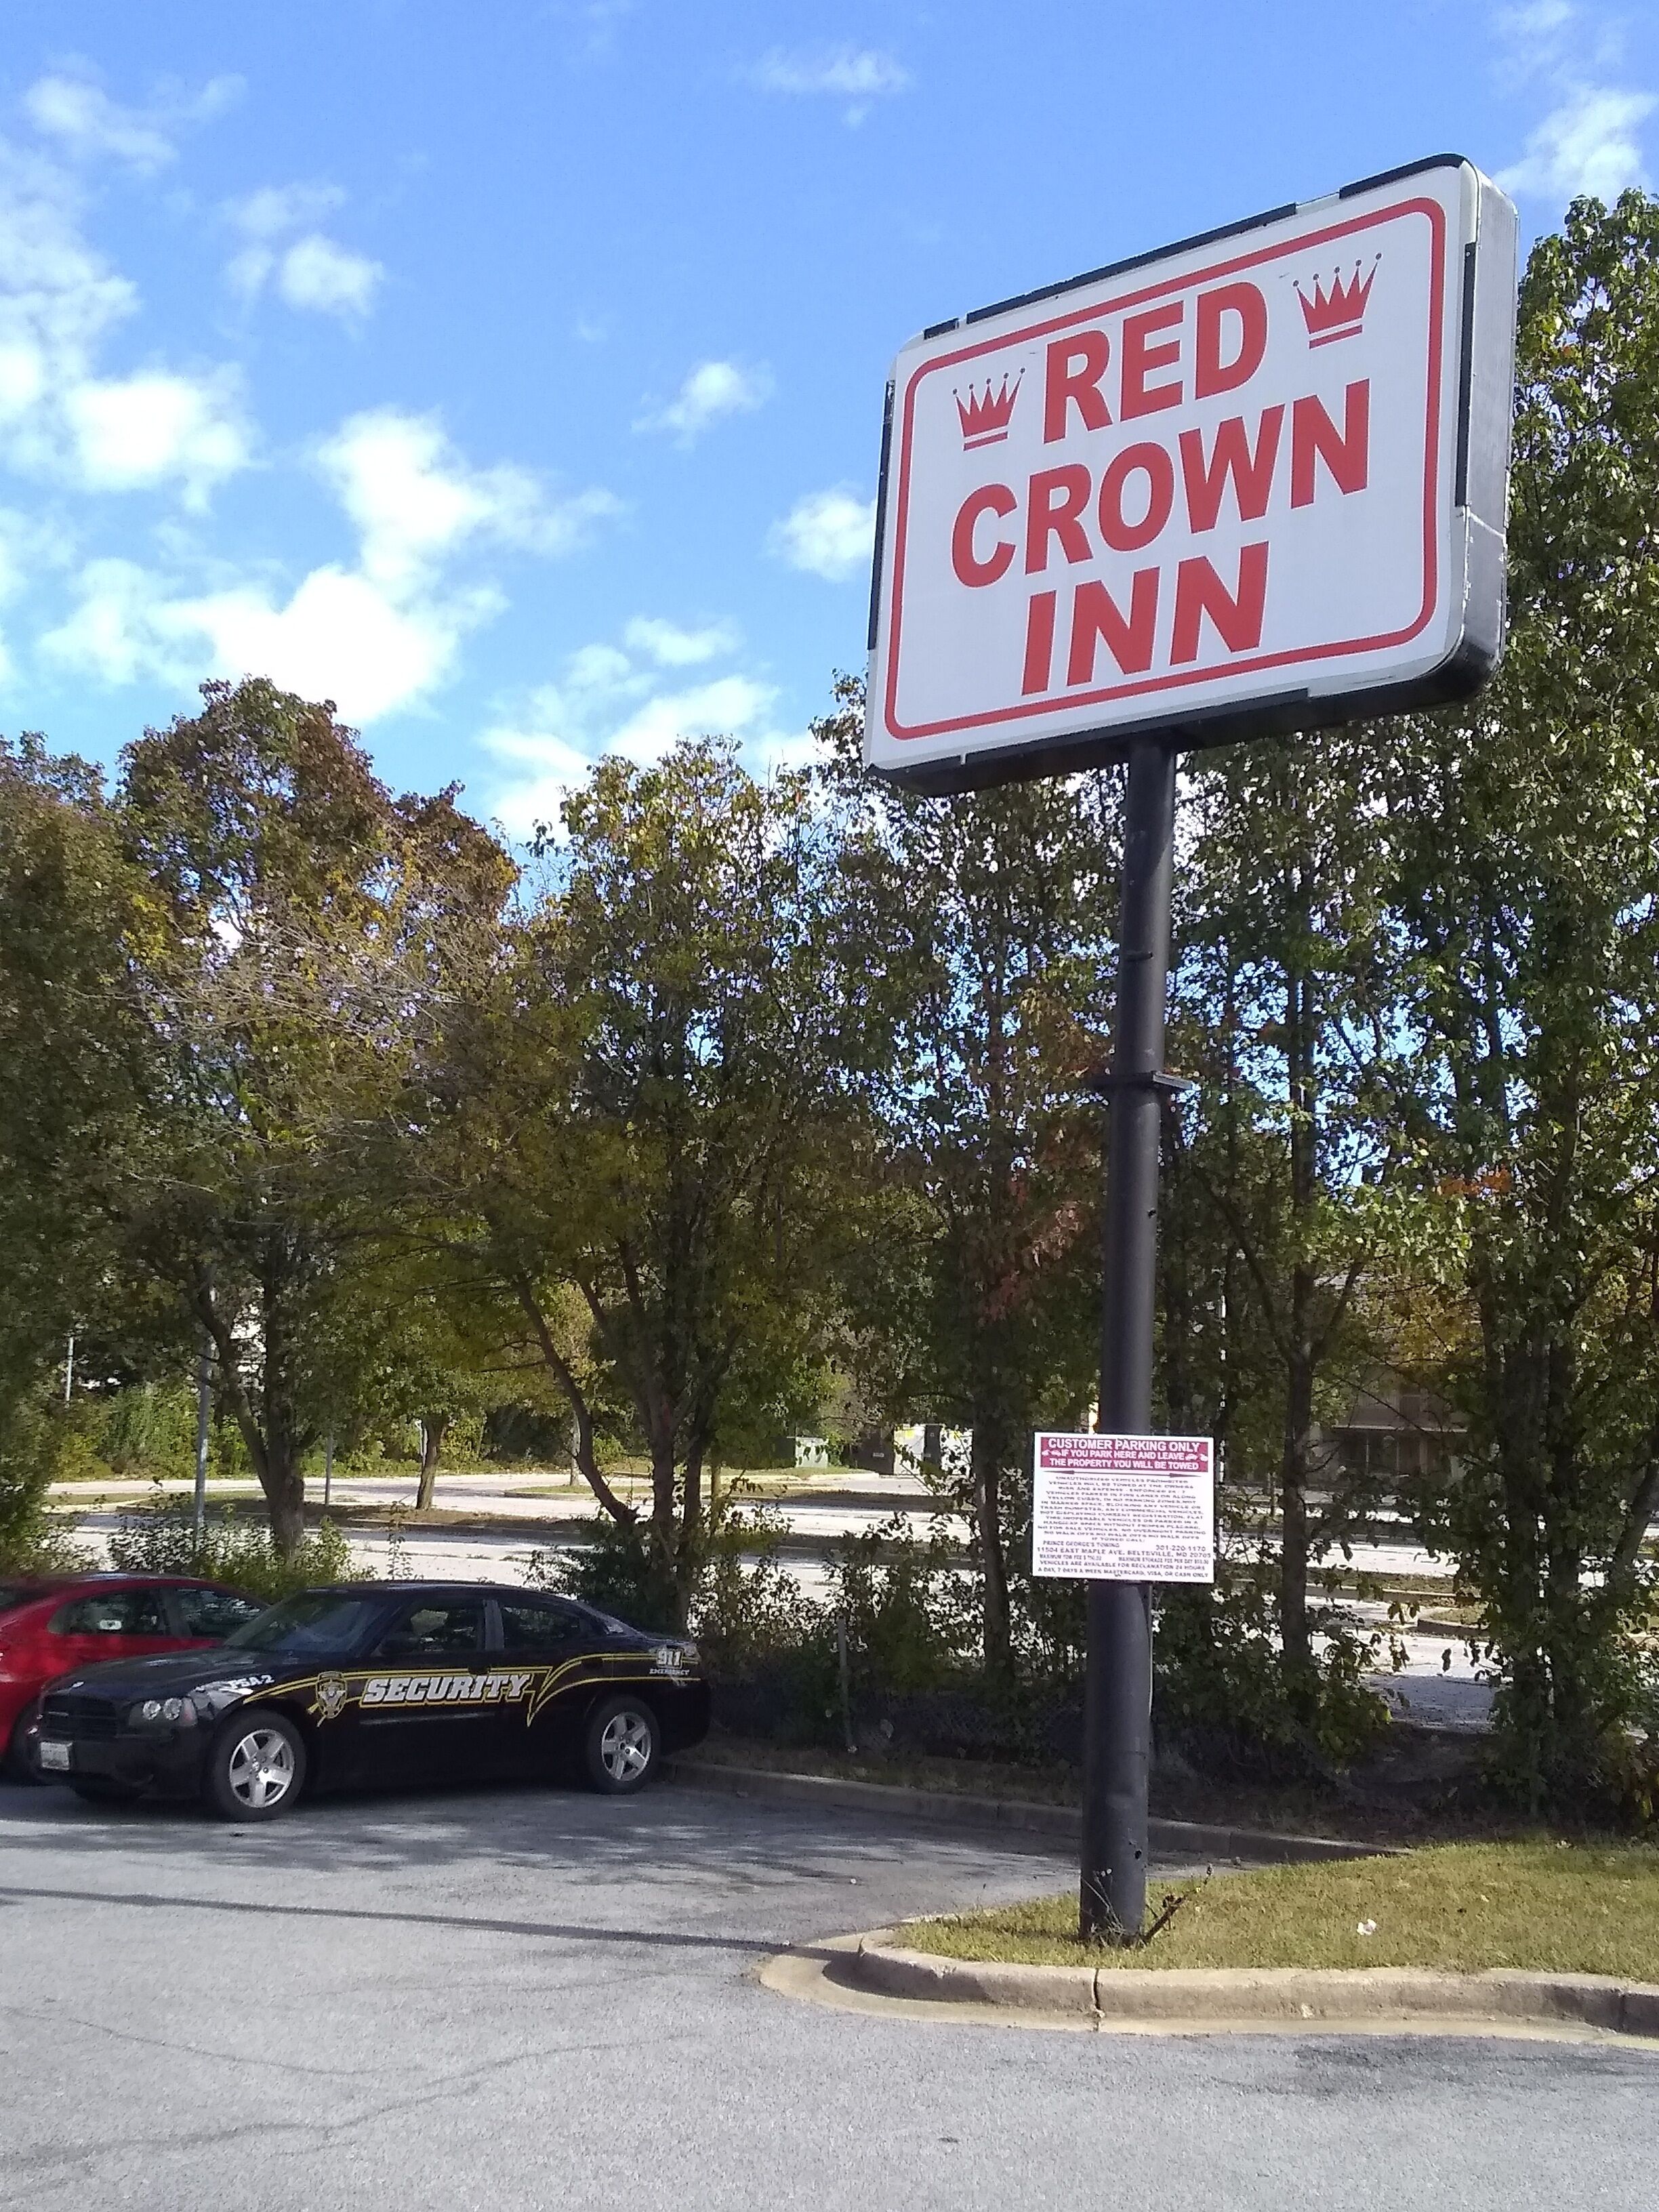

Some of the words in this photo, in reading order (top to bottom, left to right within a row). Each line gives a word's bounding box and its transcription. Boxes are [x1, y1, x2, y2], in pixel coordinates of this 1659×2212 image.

[1043, 281, 1267, 444] RED
[951, 378, 1370, 588] CROWN
[1021, 541, 1269, 696] INN
[1048, 1438, 1112, 1450] CUSTOMER
[1115, 1439, 1166, 1451] PARKING
[1169, 1441, 1201, 1452] ONLY
[1113, 1450, 1136, 1458] HERE
[1158, 1452, 1185, 1460] LEAVE
[1067, 1458, 1112, 1467] PROPERTY
[1113, 1460, 1131, 1468] YOU
[1132, 1460, 1153, 1469] WILL
[1167, 1461, 1200, 1470] TOWED
[657, 1650, 682, 1667] 911
[362, 1674, 531, 1704] SECURITY
